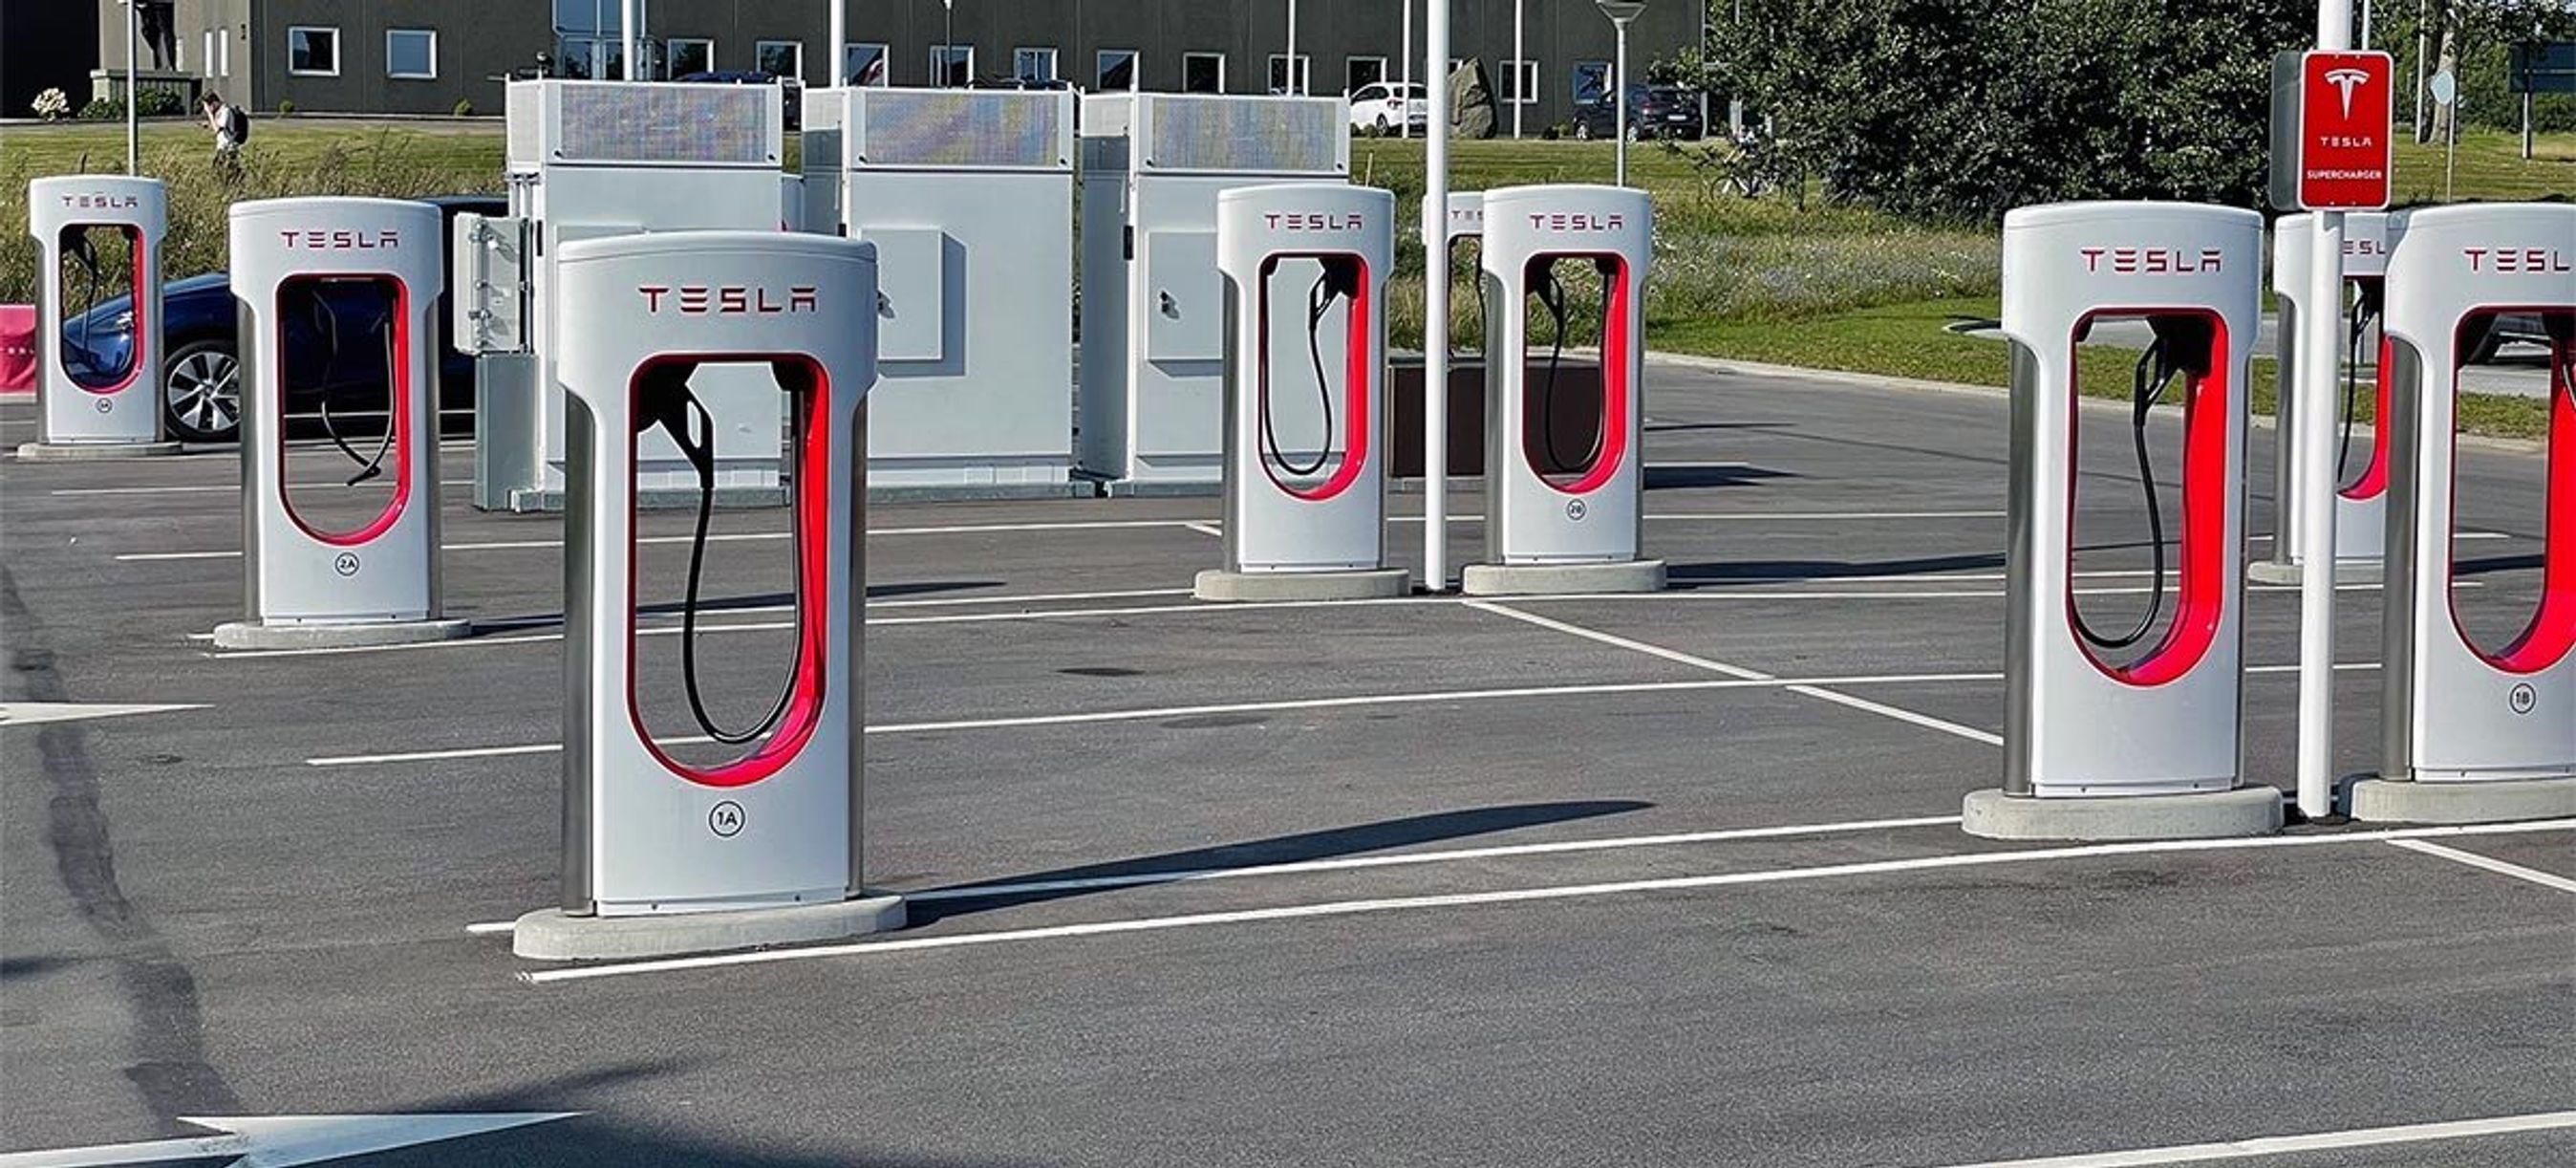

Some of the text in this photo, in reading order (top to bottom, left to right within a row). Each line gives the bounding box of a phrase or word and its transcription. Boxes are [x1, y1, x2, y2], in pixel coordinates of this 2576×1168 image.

[2320, 137, 2372, 148] TESLA
[2307, 170, 2383, 180] SUPERCHARGER
[62, 195, 138, 207] TESLA
[1264, 214, 1363, 229] TESLA
[1450, 210, 1484, 222] TES
[1530, 214, 1622, 230] TESLA
[280, 231, 398, 249] TESLA
[2342, 240, 2387, 255] ESL
[2080, 249, 2222, 272] TESLA
[2464, 249, 2571, 271] TESL
[637, 288, 817, 314] TESLA
[717, 811, 738, 826] 1A
